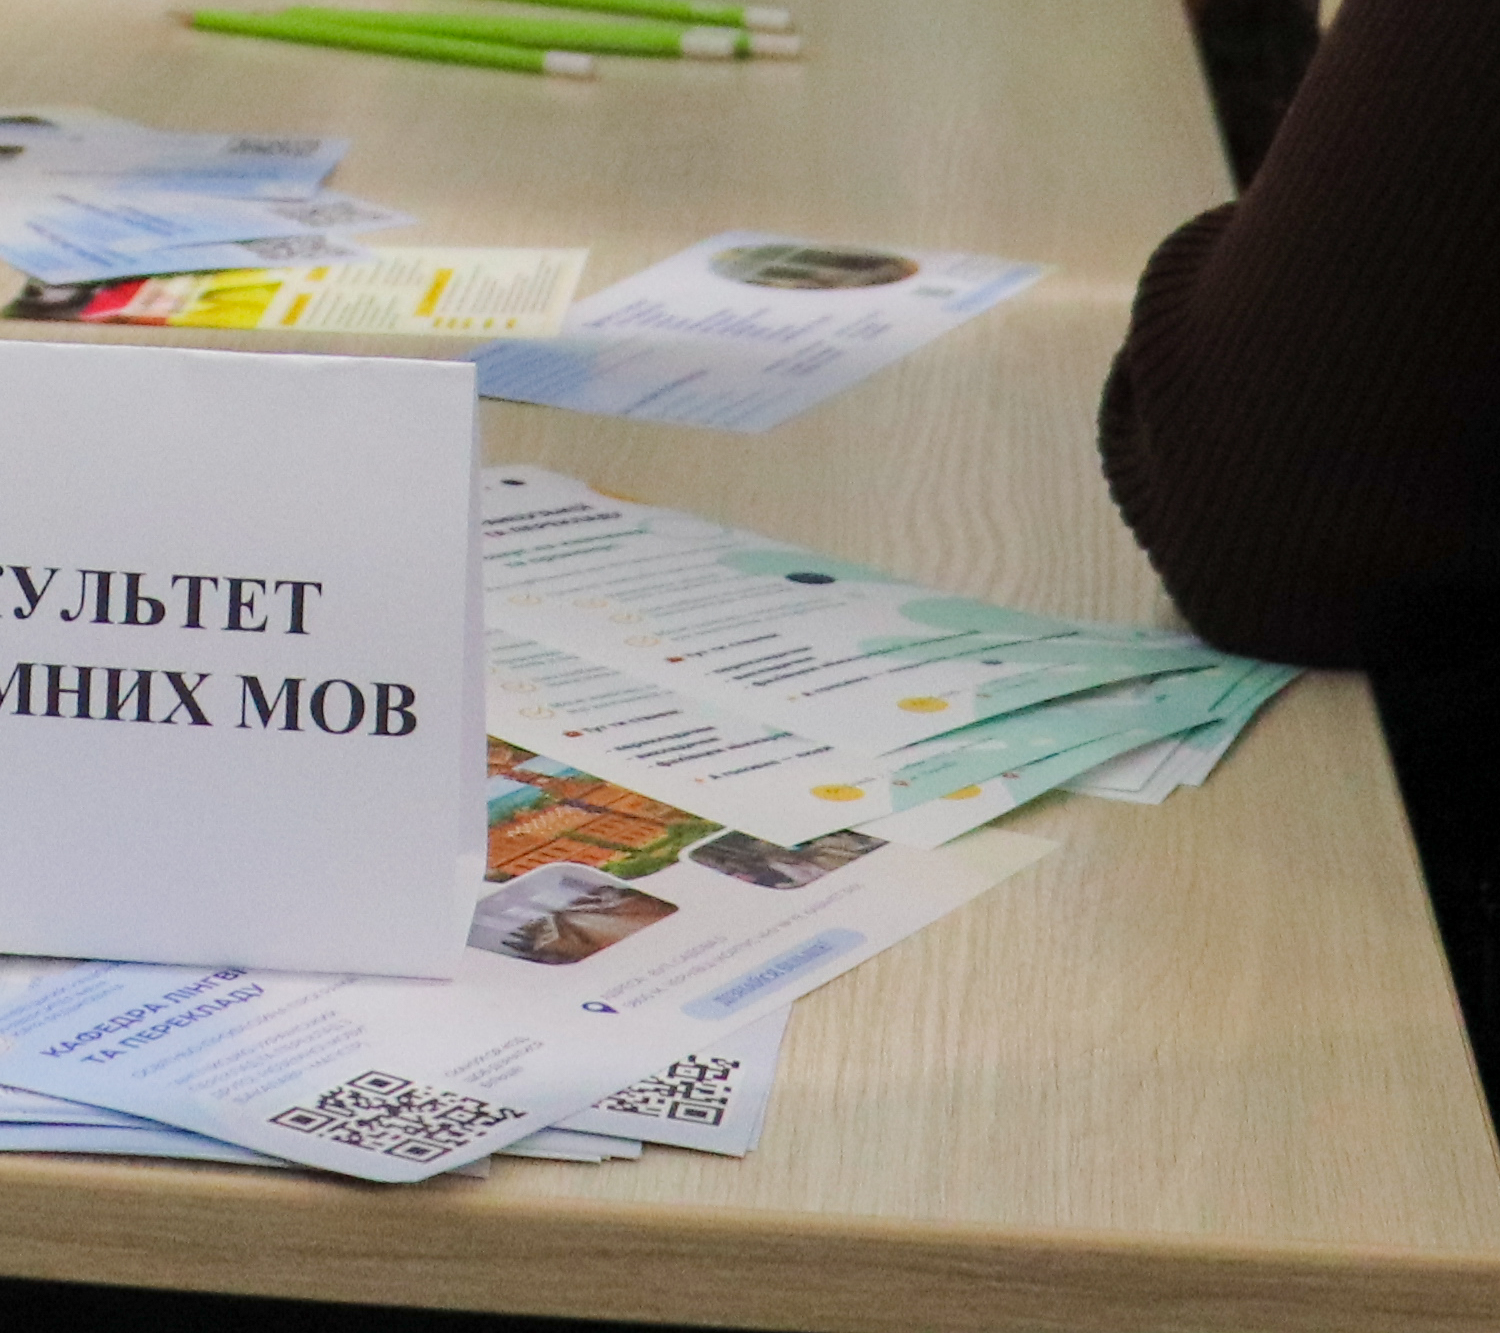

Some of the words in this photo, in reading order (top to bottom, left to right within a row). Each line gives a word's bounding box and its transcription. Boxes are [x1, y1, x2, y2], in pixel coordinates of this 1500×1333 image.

[235, 674, 420, 738] МОВ
[40, 1001, 165, 1060] КАФЕДРА
[80, 1046, 127, 1066] ТА
[126, 982, 265, 1051] ПЕРЕКЛАДУ
